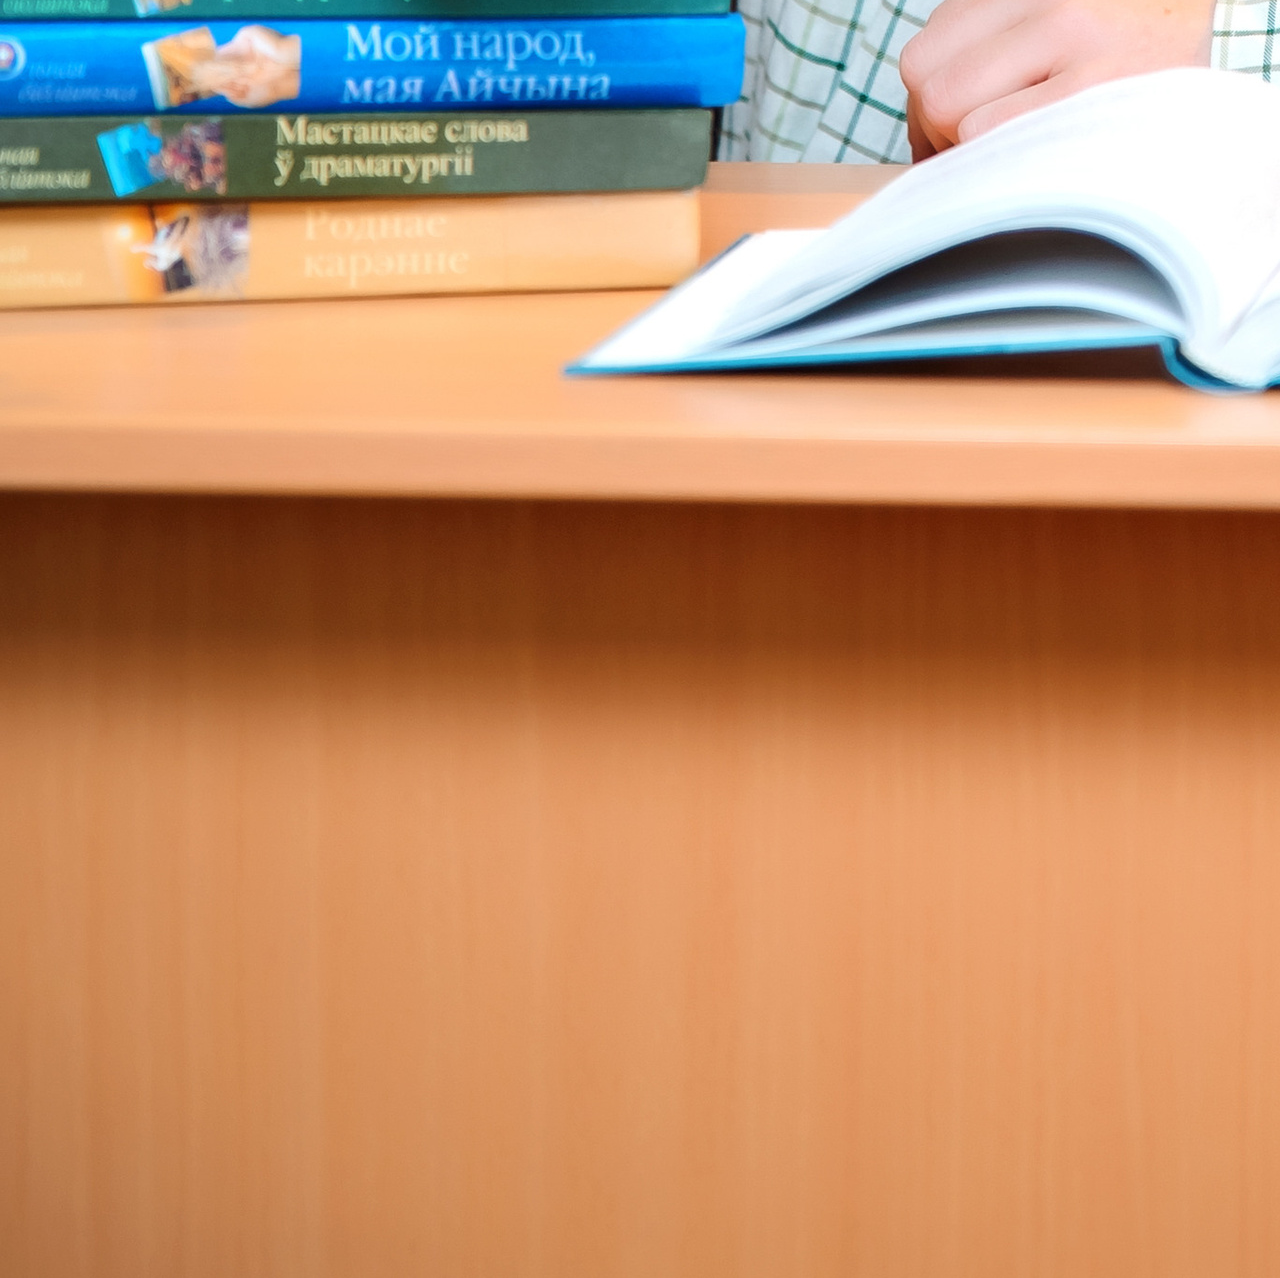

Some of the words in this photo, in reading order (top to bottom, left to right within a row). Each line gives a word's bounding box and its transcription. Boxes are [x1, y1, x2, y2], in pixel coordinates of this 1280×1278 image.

[344, 23, 441, 62] Мой
[452, 29, 596, 72] народ,
[341, 75, 425, 104] мая
[432, 68, 612, 103] Айчына
[276, 114, 438, 146] Мастацкае
[444, 118, 529, 143] слова
[300, 144, 475, 186] драматургіі
[304, 209, 448, 242] Роднае
